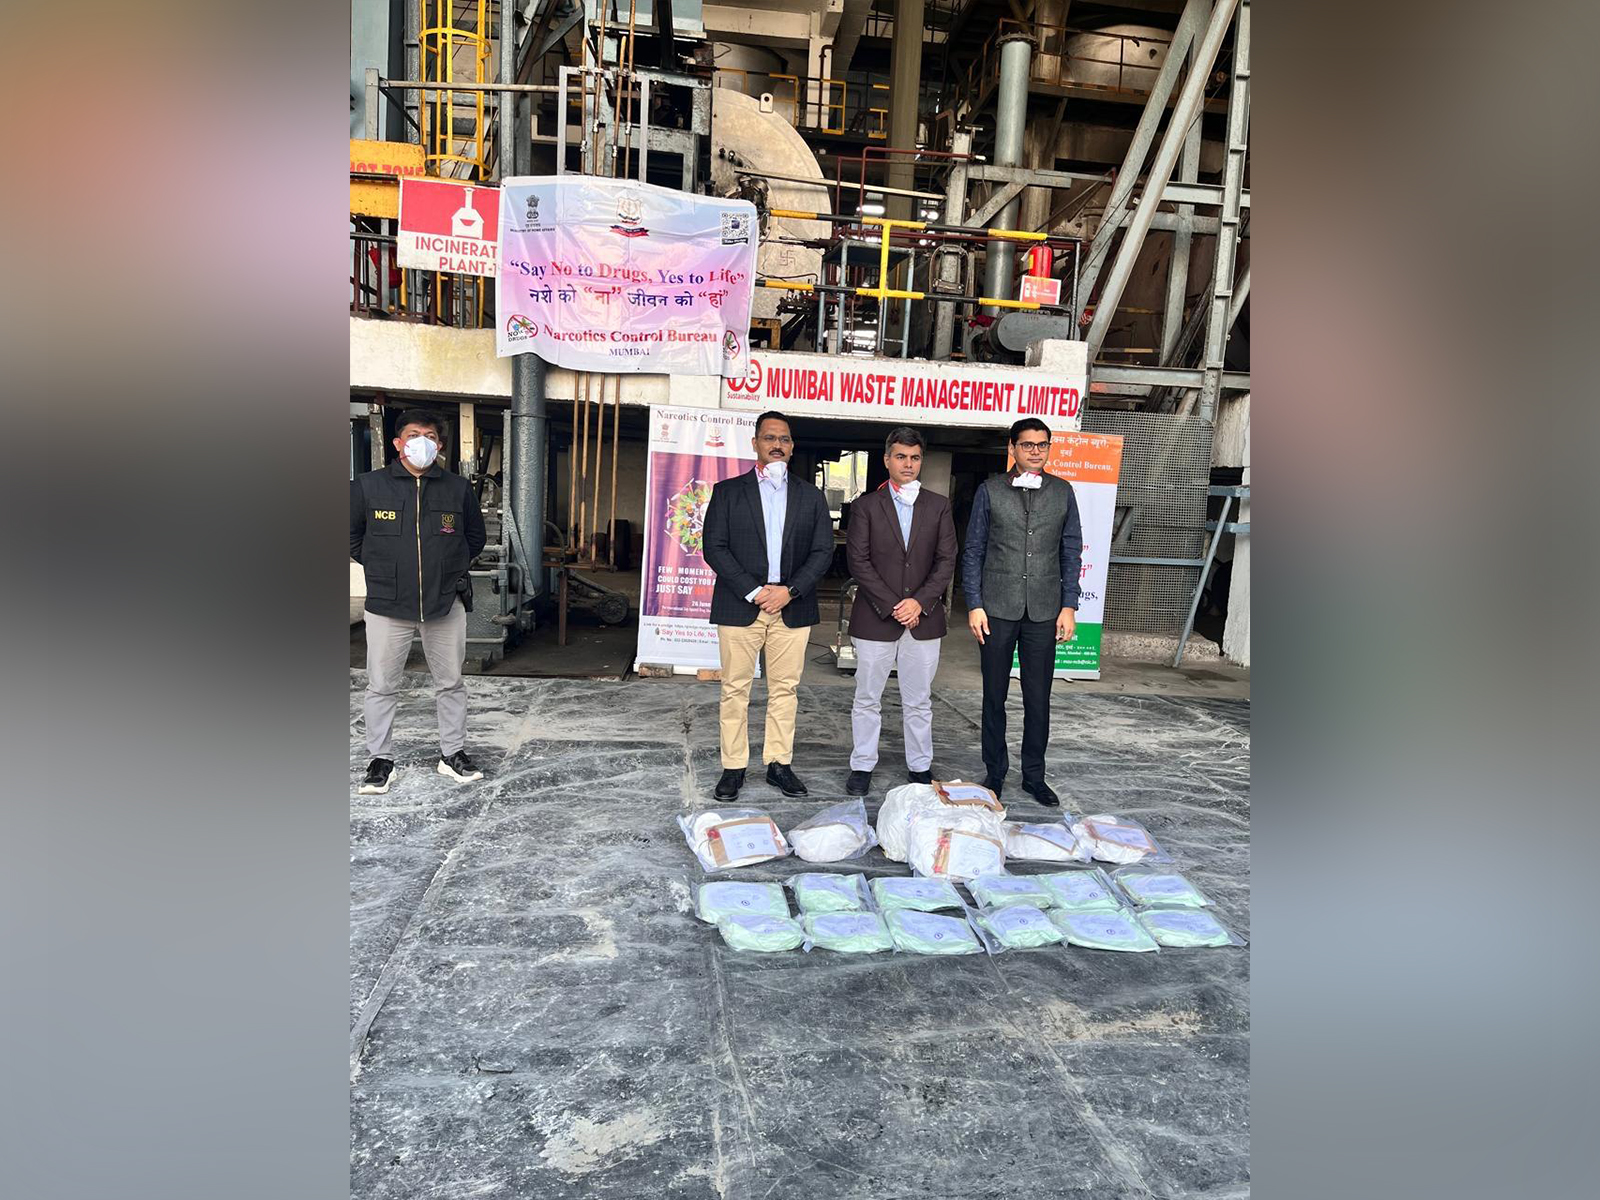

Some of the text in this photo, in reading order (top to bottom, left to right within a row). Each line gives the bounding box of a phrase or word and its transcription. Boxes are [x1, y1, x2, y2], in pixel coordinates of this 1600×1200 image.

[510, 259, 745, 284] “Say No to Drugs, Yes to Life”
[529, 284, 553, 303] नशे
[558, 283, 577, 303] को
[584, 286, 621, 305] “ना”
[627, 288, 669, 307] जीवन
[674, 290, 694, 307] को
[543, 324, 717, 343] Narcotics Control Bureau
[609, 348, 650, 356] MUMBAI
[766, 367, 834, 402] MUMBAI
[840, 371, 896, 406] WASTE
[900, 377, 1015, 412] MANAGEMENT
[1018, 384, 1080, 417] LIMITED
[657, 410, 698, 421] Narcotics
[700, 414, 734, 425] Control
[1053, 459, 1082, 469] Control
[1084, 461, 1113, 471] Bureau,
[1052, 469, 1077, 477] Mumbai
[374, 510, 396, 520] NCB
[658, 566, 713, 577] FEW MOMENTS
[658, 575, 679, 584] COULD
[680, 577, 698, 585] COST
[698, 578, 712, 586] YOU
[656, 584, 676, 593] JUST
[677, 585, 694, 595] SAY
[661, 629, 673, 637] Say
[708, 631, 717, 639] No
